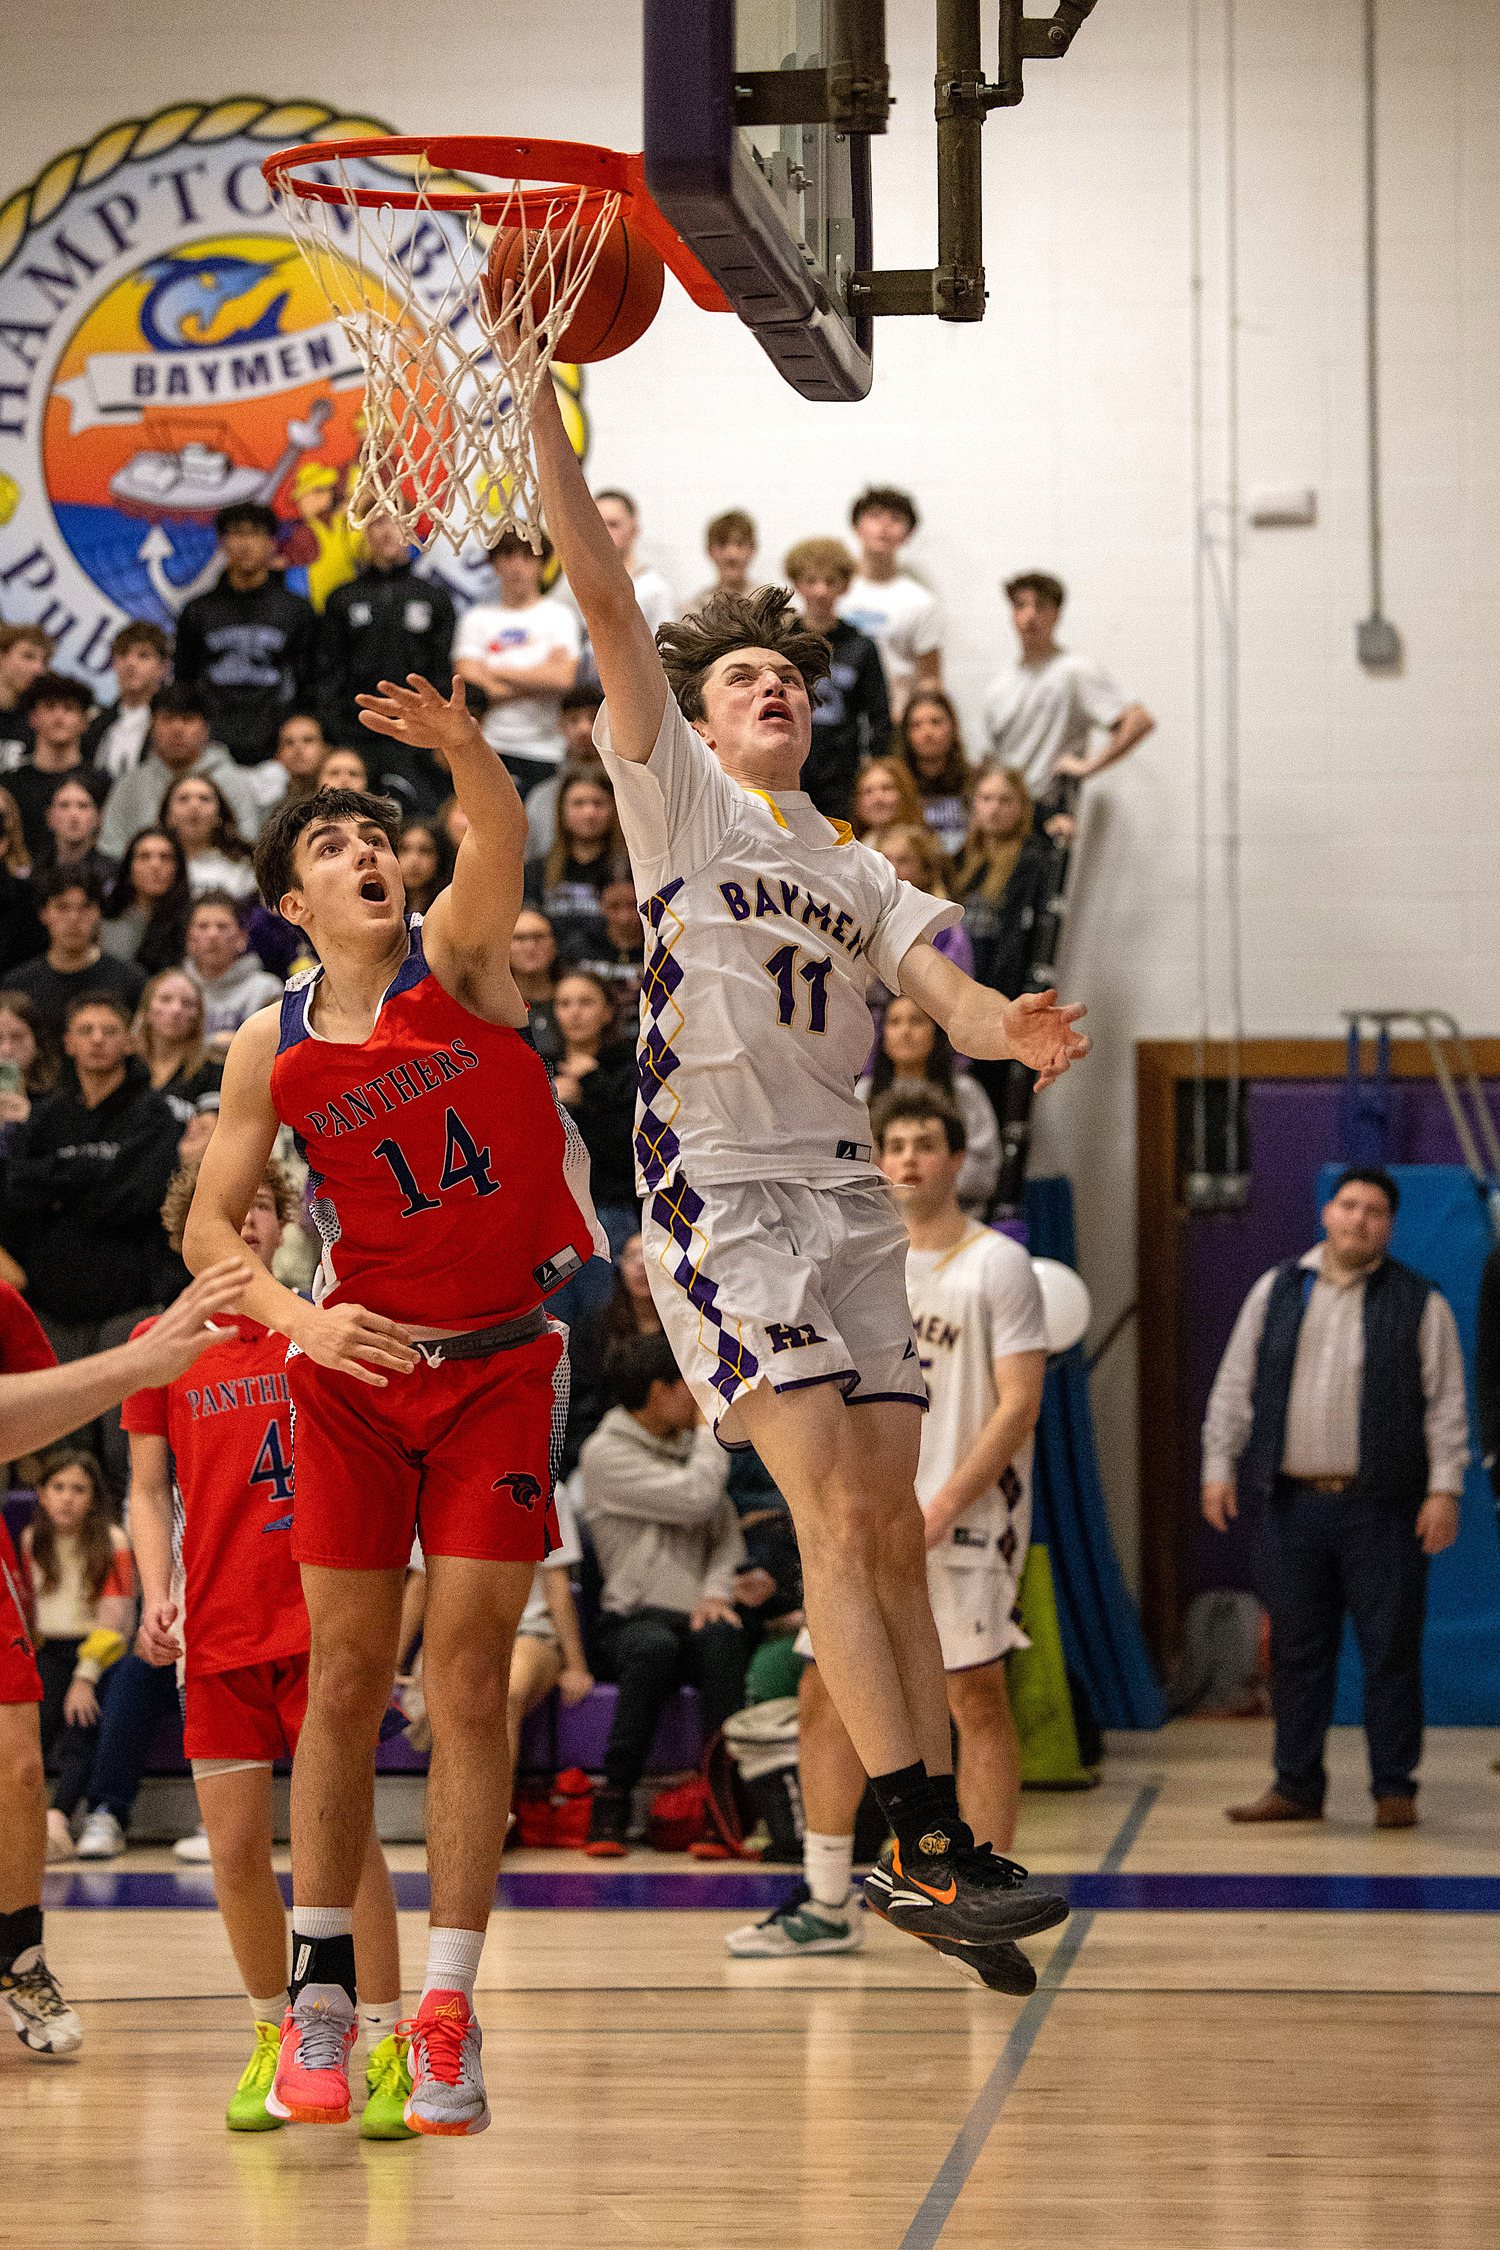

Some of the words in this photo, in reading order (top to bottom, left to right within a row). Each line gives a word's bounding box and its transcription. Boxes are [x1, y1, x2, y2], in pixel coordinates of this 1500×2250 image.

[132, 334, 334, 398] BAYMEN
[717, 875, 865, 962] BAYMEN
[762, 942, 833, 1036] 11
[305, 1038, 479, 1138] PANTHERS
[373, 1106, 501, 1219] 14
[248, 1418, 294, 1502] 4
